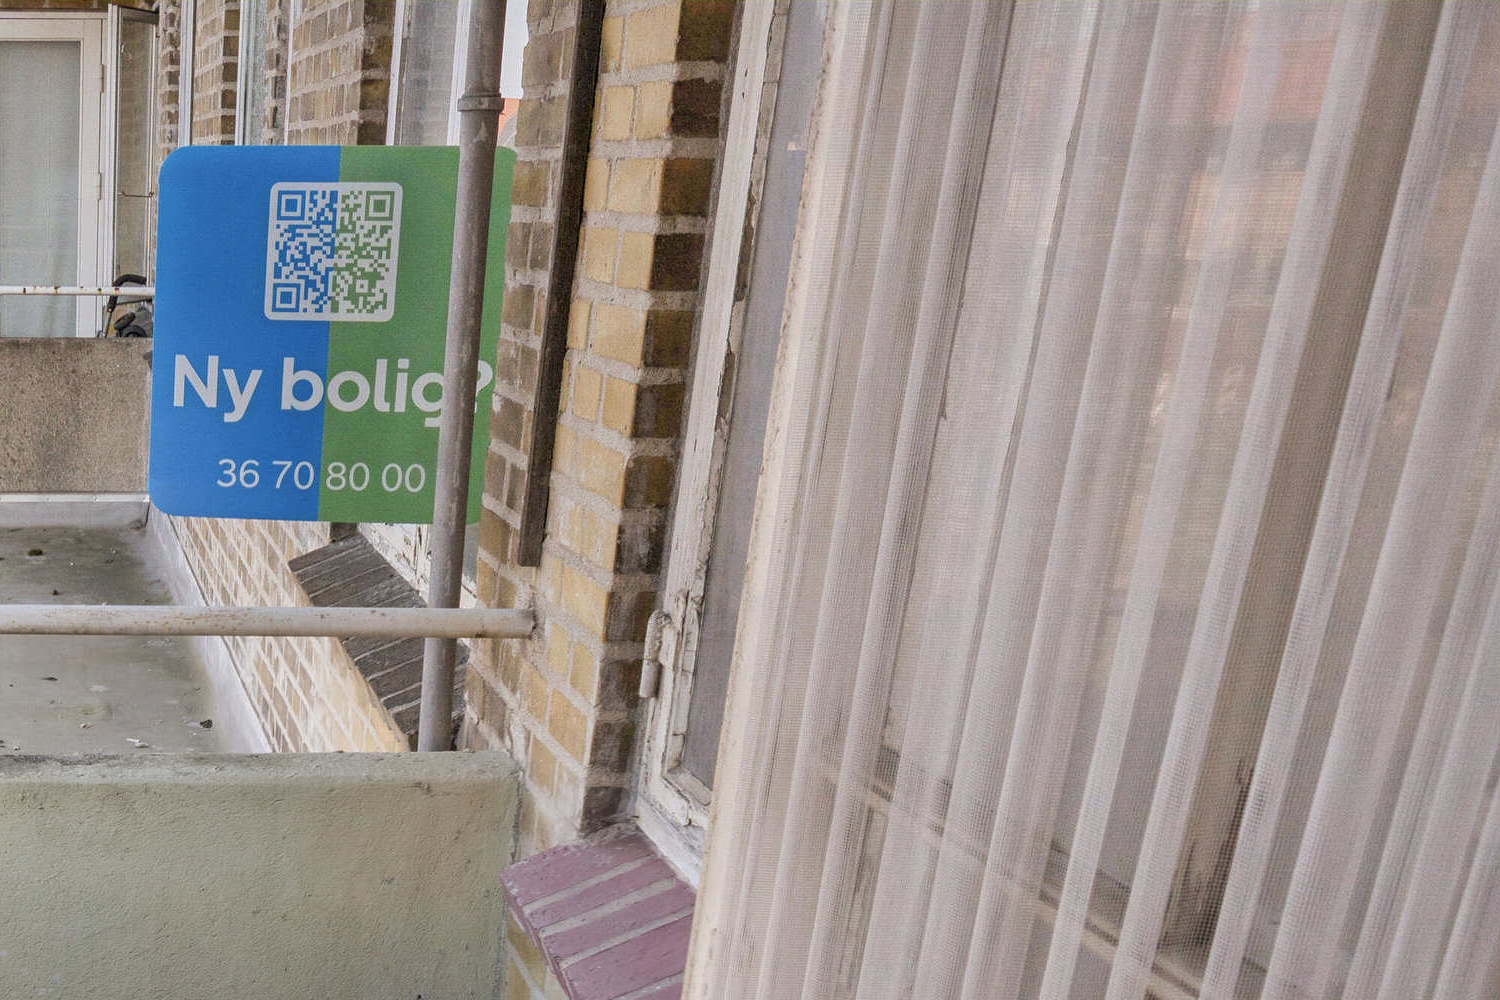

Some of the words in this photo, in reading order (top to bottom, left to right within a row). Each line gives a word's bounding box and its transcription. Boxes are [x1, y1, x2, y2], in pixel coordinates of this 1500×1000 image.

[173, 354, 263, 423] Ny
[216, 458, 261, 489] 36
[272, 460, 315, 491] 70
[325, 461, 370, 492] 80
[381, 462, 426, 493] 00
